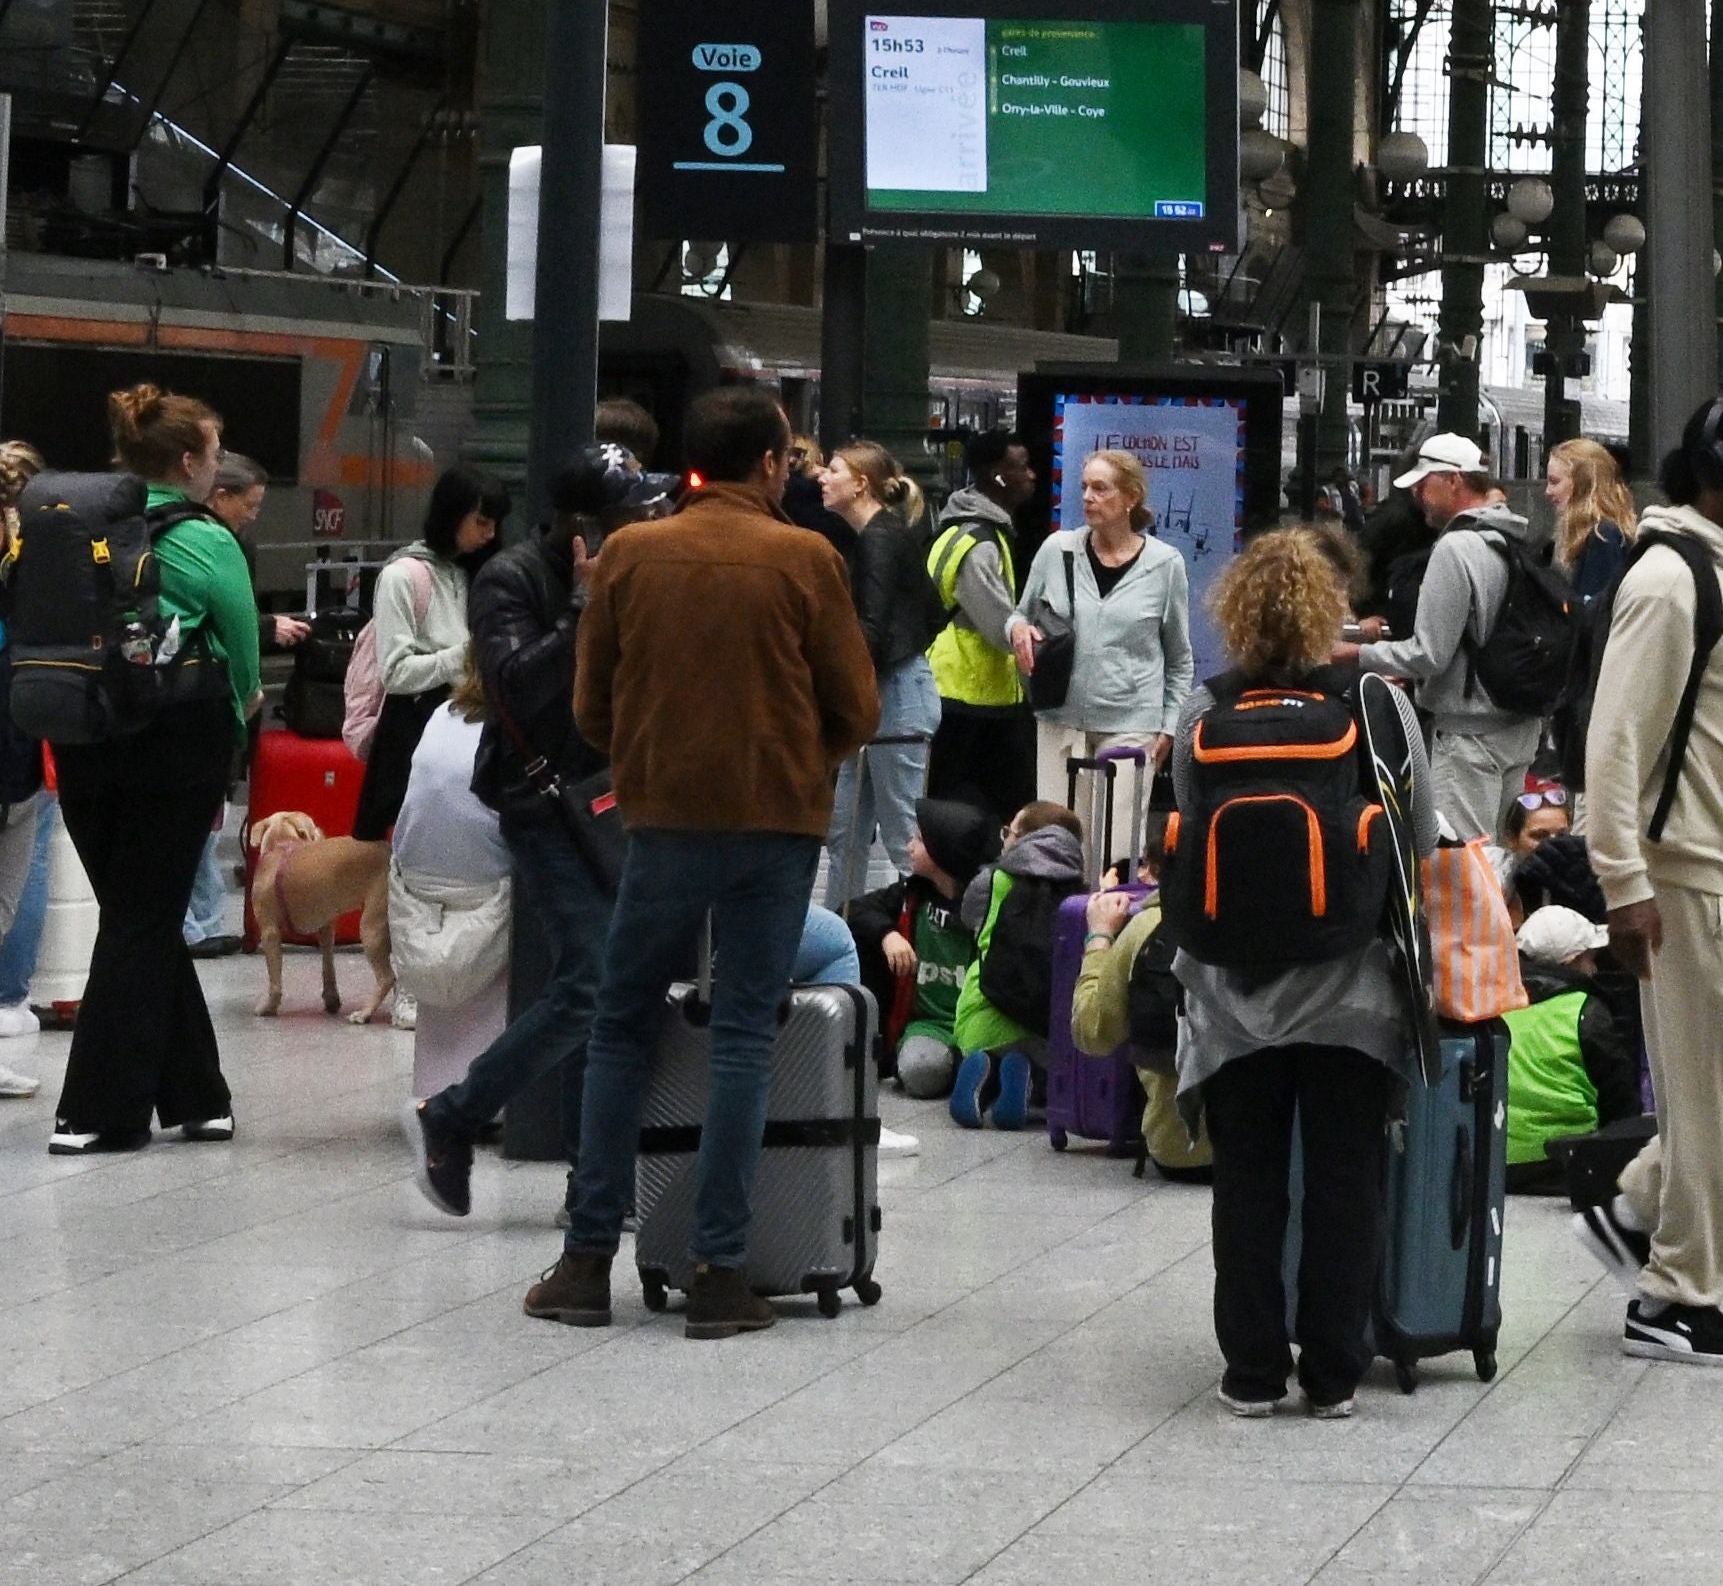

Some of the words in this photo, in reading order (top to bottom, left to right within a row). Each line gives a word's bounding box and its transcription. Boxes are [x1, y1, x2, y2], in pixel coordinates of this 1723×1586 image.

[872, 39, 924, 53] 15h53
[1002, 45, 1026, 56] Creil
[701, 47, 752, 68] Voie
[871, 65, 909, 79] Creil
[1002, 74, 1050, 88] Chantilly
[1060, 76, 1110, 87] Gouvieux
[1002, 103, 1069, 117] Orry-la-Ville
[1078, 105, 1105, 118] Coye
[703, 81, 753, 157] 8
[1363, 370, 1380, 395] R
[1123, 434, 1168, 451] COCHON
[1174, 436, 1200, 452] EST
[1155, 456, 1169, 469] LE
[314, 508, 343, 531] SNCF
